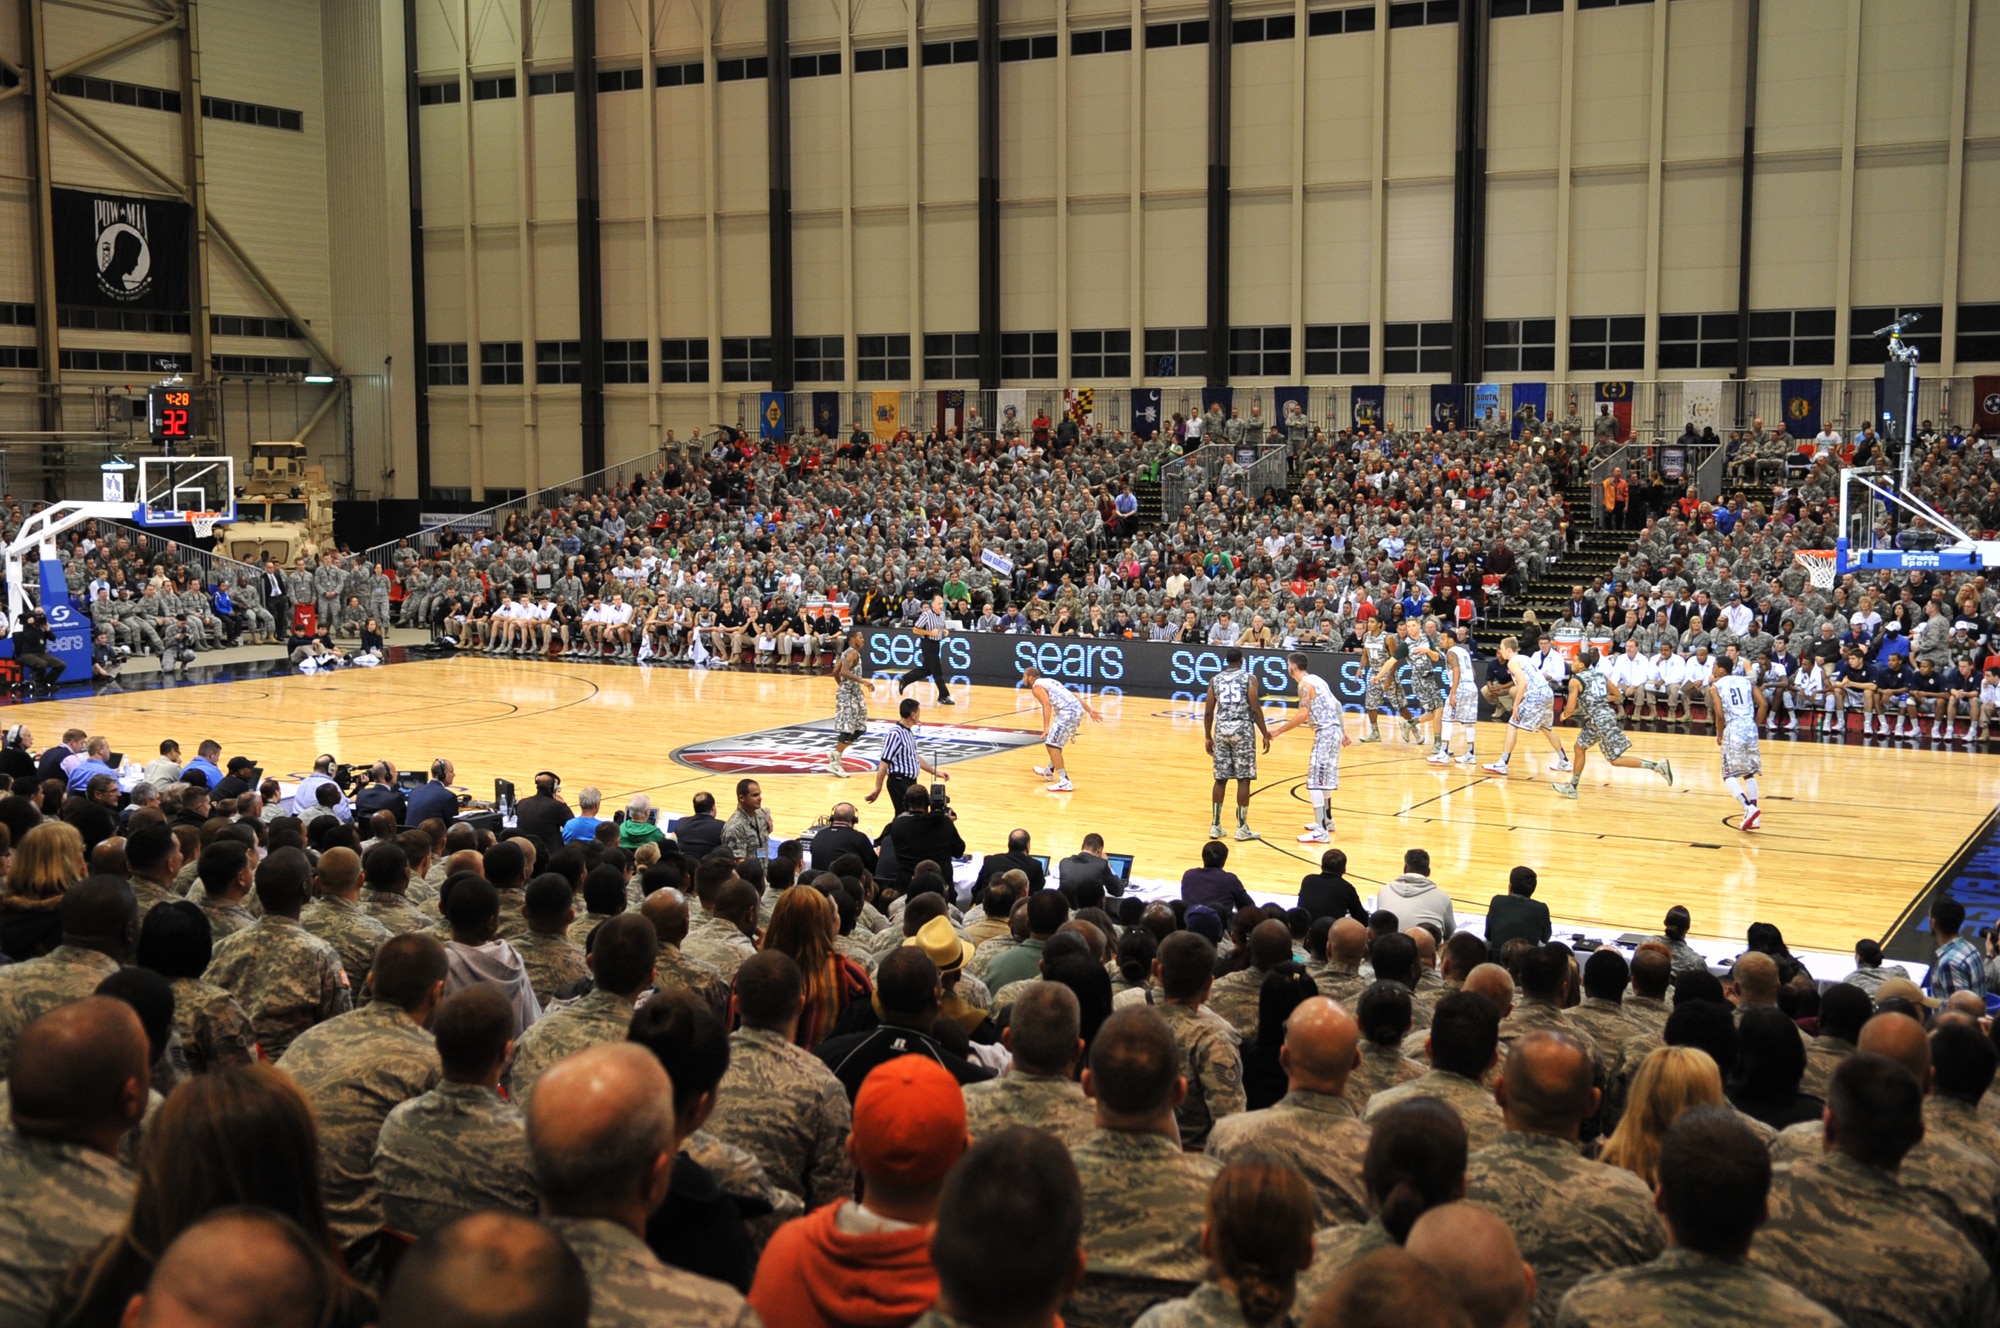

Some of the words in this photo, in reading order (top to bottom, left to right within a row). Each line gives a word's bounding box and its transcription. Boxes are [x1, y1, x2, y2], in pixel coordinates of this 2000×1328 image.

[94, 199, 119, 241] POW
[126, 203, 148, 242] MIA
[165, 392, 190, 406] 4:28
[163, 410, 188, 435] 32
[1902, 560, 1939, 568] Sports
[46, 635, 84, 654] ears
[1014, 641, 1124, 680] sears
[1219, 683, 1242, 703] 25
[1591, 679, 1608, 698] 45
[1729, 687, 1744, 706] 21
